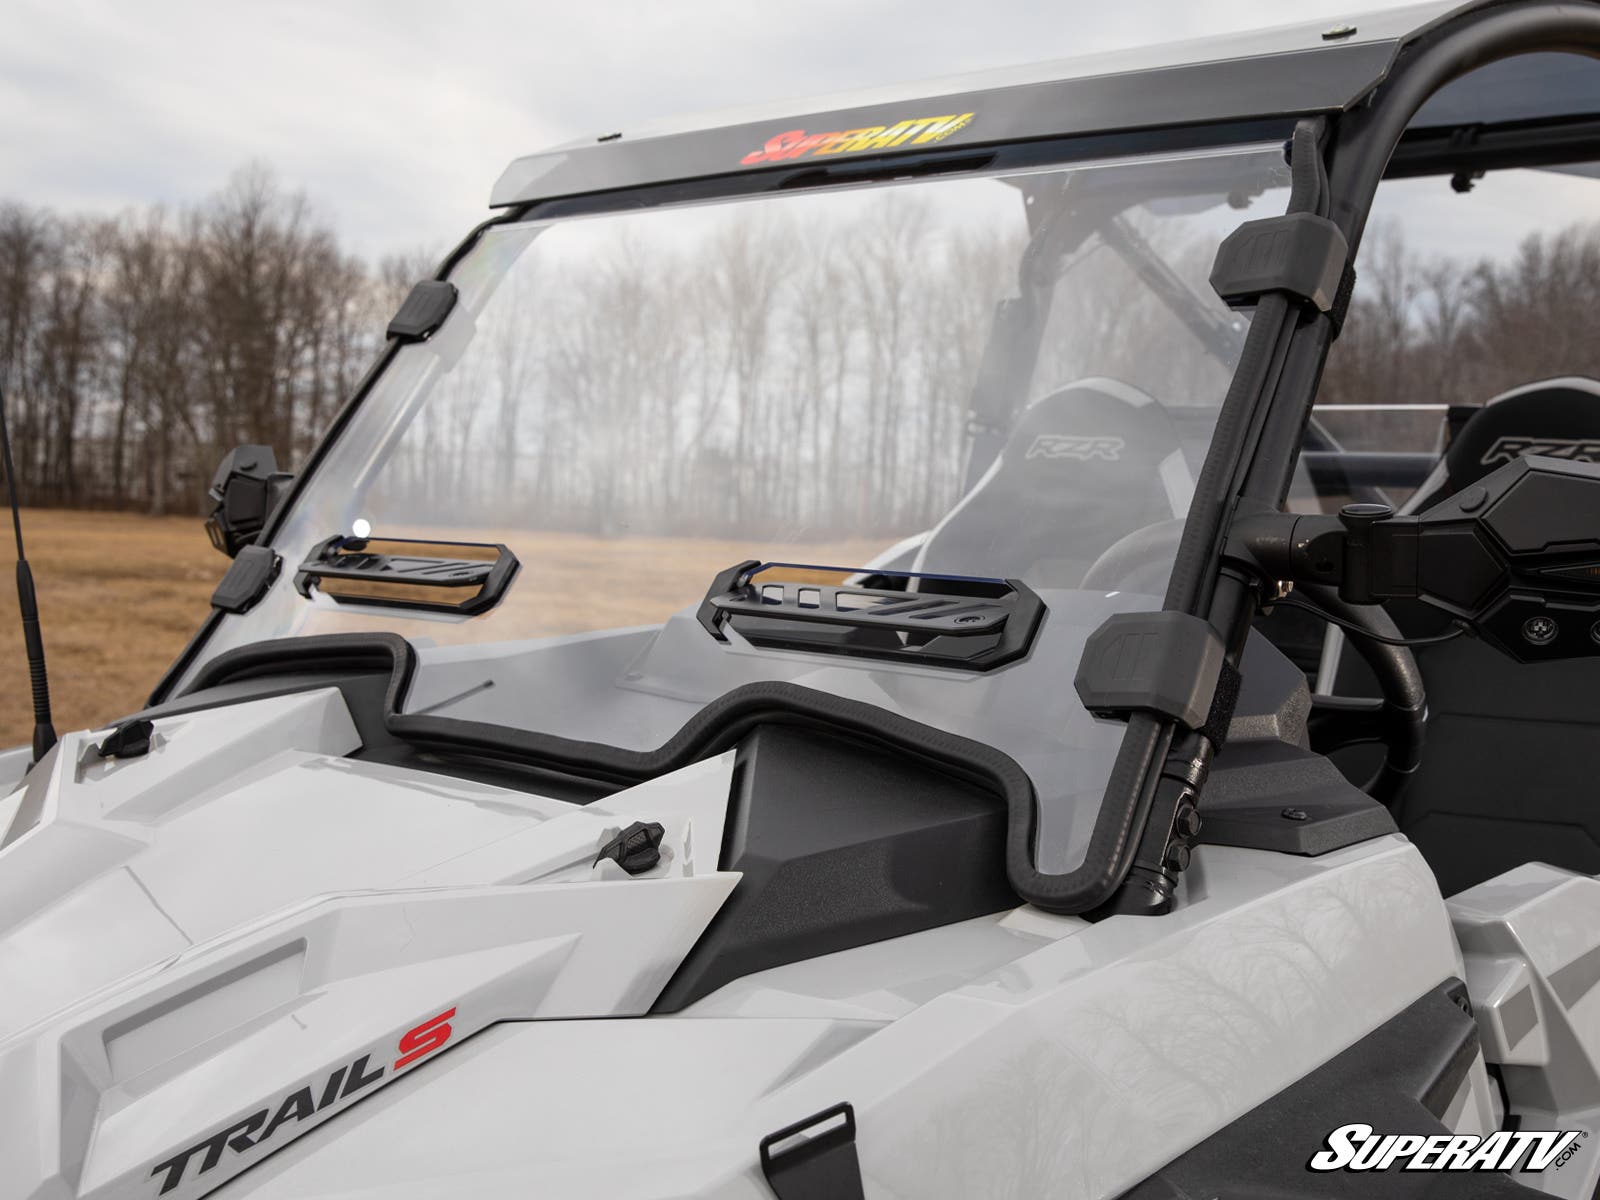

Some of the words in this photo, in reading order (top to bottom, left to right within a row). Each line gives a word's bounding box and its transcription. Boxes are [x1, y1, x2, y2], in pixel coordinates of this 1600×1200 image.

[740, 112, 975, 165] SUPERATV
[1025, 434, 1126, 460] RZR
[150, 1053, 385, 1196] TRAIL
[393, 1006, 457, 1071] S
